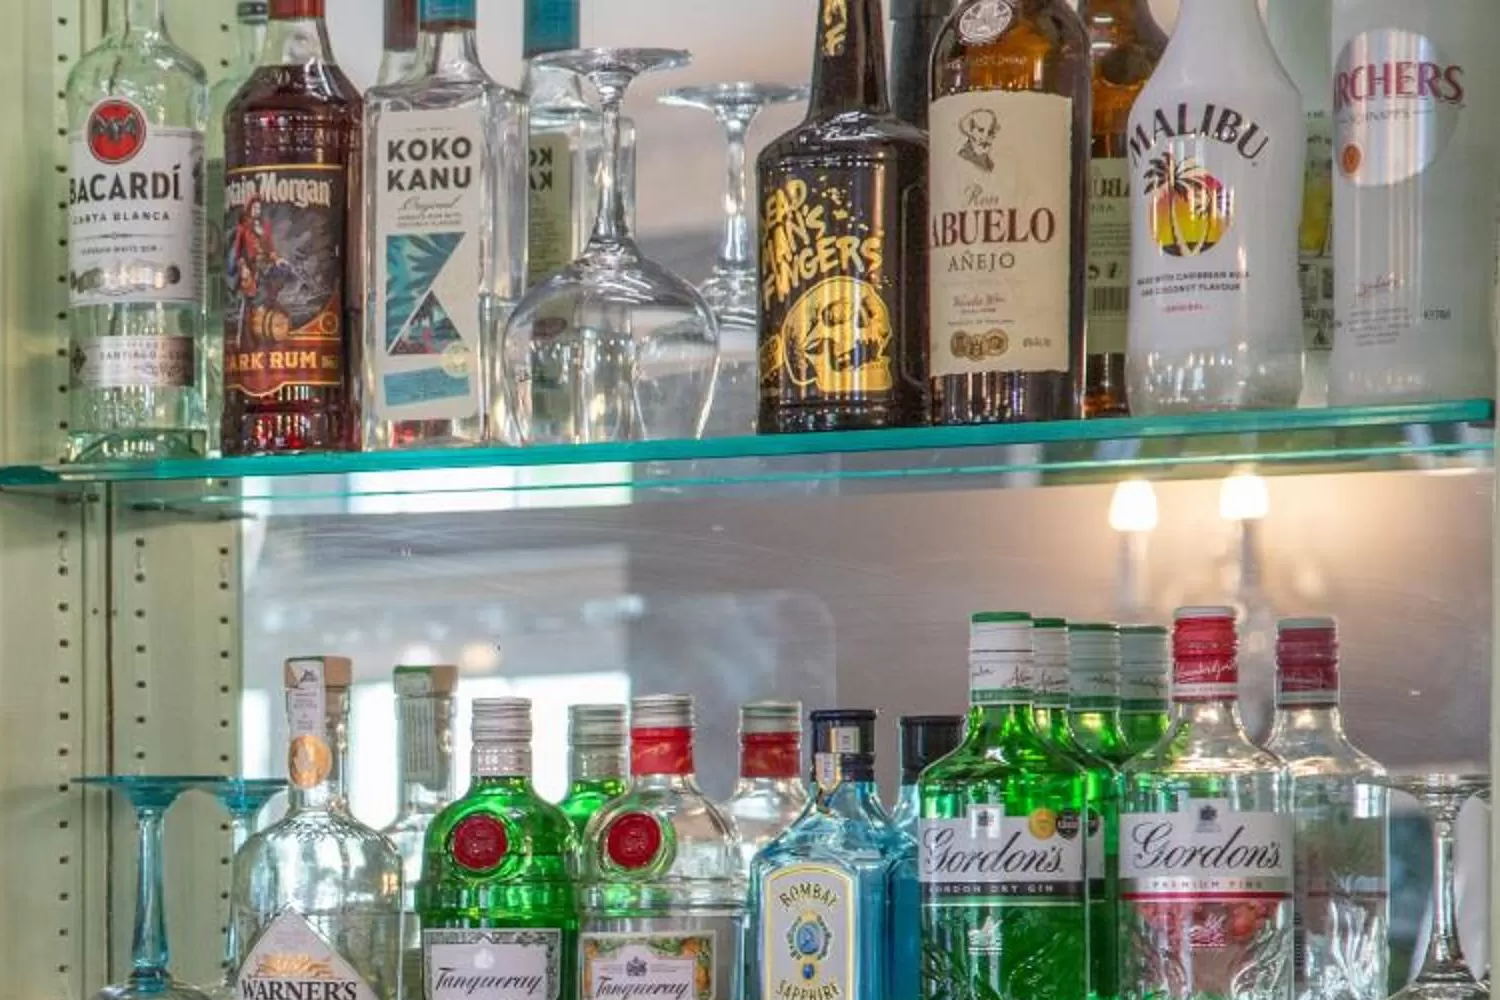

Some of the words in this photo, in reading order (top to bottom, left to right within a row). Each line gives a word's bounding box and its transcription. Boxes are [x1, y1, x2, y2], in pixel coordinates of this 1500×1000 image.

[1129, 102, 1269, 169] MALIBU
[387, 136, 472, 162] KOKO
[226, 175, 257, 212] tain
[255, 171, 331, 208] Morgan
[387, 166, 471, 192] KANU
[113, 211, 170, 221] BLANCA
[947, 250, 1015, 272] AÑEJO
[229, 351, 265, 372] ARK
[269, 351, 317, 369] RUM
[923, 827, 1064, 875] Gordon's
[1132, 821, 1281, 870] Gordon's
[779, 883, 837, 908] BOMBAY
[929, 884, 981, 894] LONDON
[990, 884, 1018, 894] DRY
[1028, 884, 1053, 894] GIN
[1153, 880, 1220, 889] PREMIUM
[435, 967, 542, 996] Tanqueray
[596, 976, 690, 1000] Tanqueray
